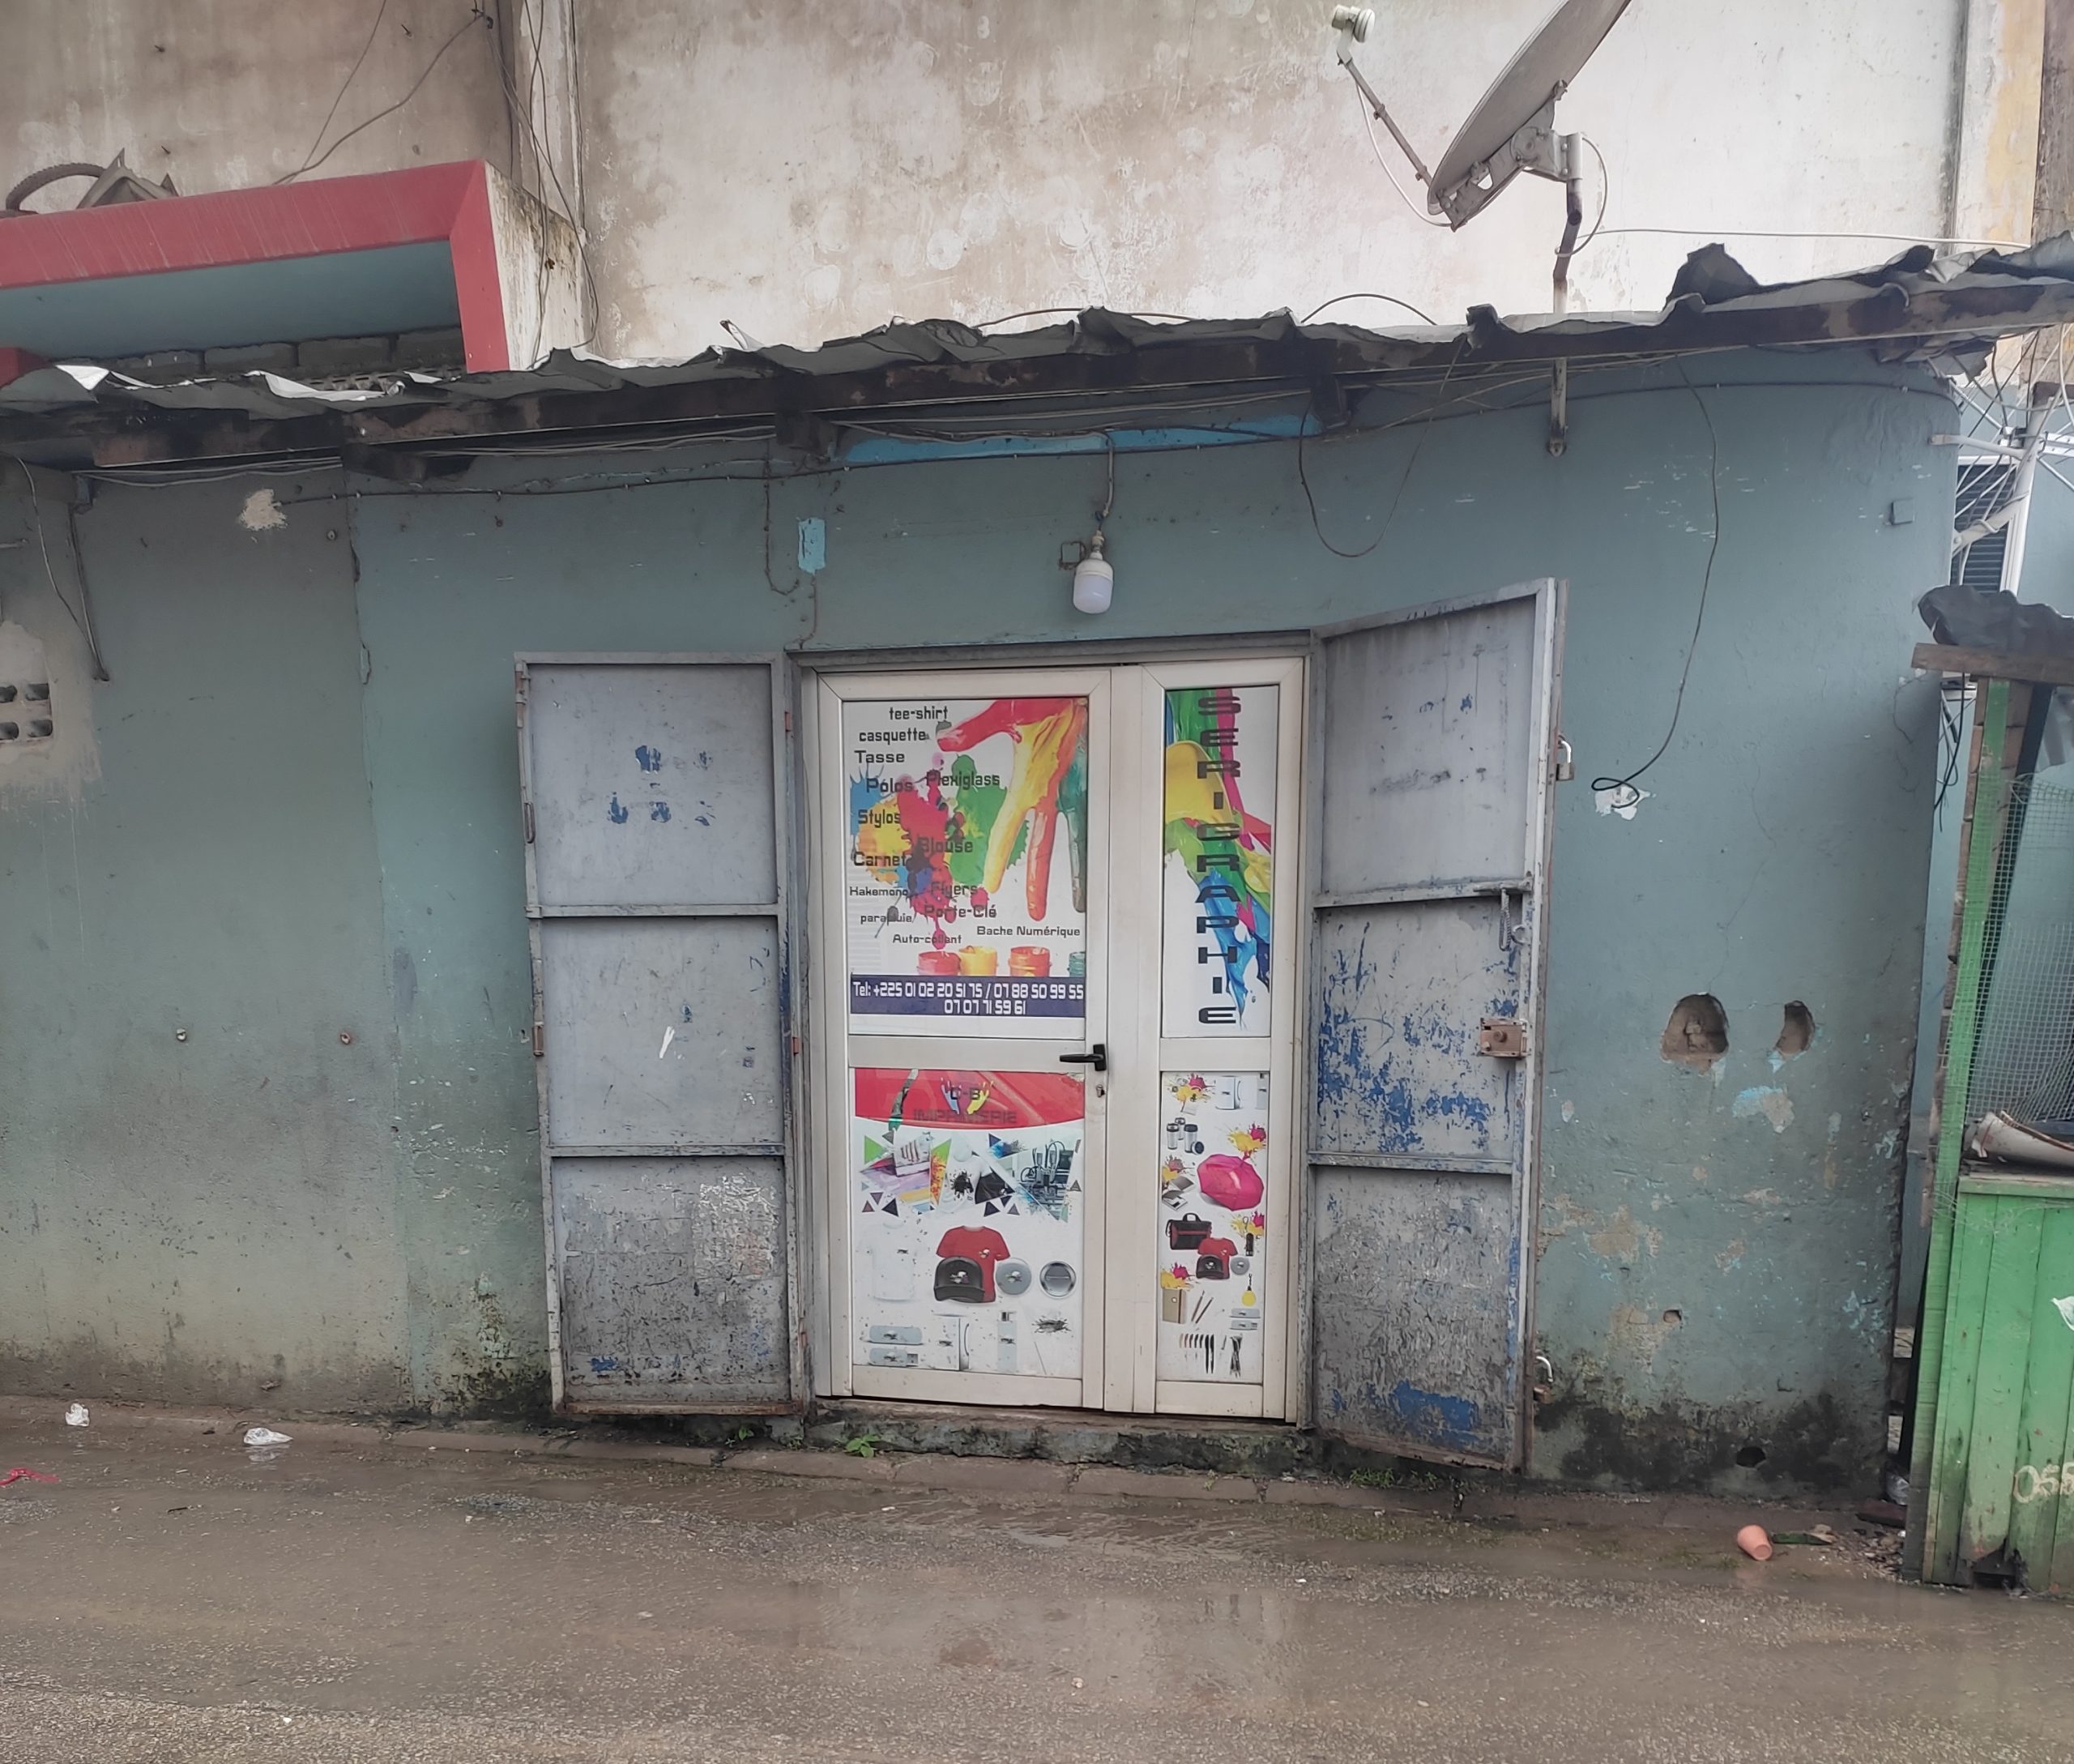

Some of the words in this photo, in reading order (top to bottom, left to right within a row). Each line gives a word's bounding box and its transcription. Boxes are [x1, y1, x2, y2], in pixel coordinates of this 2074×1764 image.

[889, 706, 949, 720] tee-shirt
[859, 728, 926, 745] casquette
[854, 750, 905, 763] Tasse
[857, 809, 901, 828] Stylos
[918, 836, 973, 853] Blouse
[853, 851, 906, 866] Carnet
[892, 933, 962, 944] Auto-collant
[976, 925, 1013, 936] Bache
[1017, 925, 1081, 939] Numérique
[873, 981, 903, 997] +225
[905, 982, 916, 997] 01
[919, 982, 934, 997] 02
[937, 983, 953, 997] 20
[955, 983, 967, 997] 51
[968, 983, 983, 998] 75
[993, 983, 1009, 998] 07
[1011, 983, 1029, 999] 88
[1031, 984, 1048, 999] 50
[1049, 984, 1066, 999] 99
[1069, 984, 1084, 1000] 55
[944, 999, 960, 1014] 07
[962, 999, 979, 1014] 07
[983, 1000, 992, 1014] 71
[995, 1000, 1012, 1014] 59
[1014, 1000, 1026, 1014] 61
